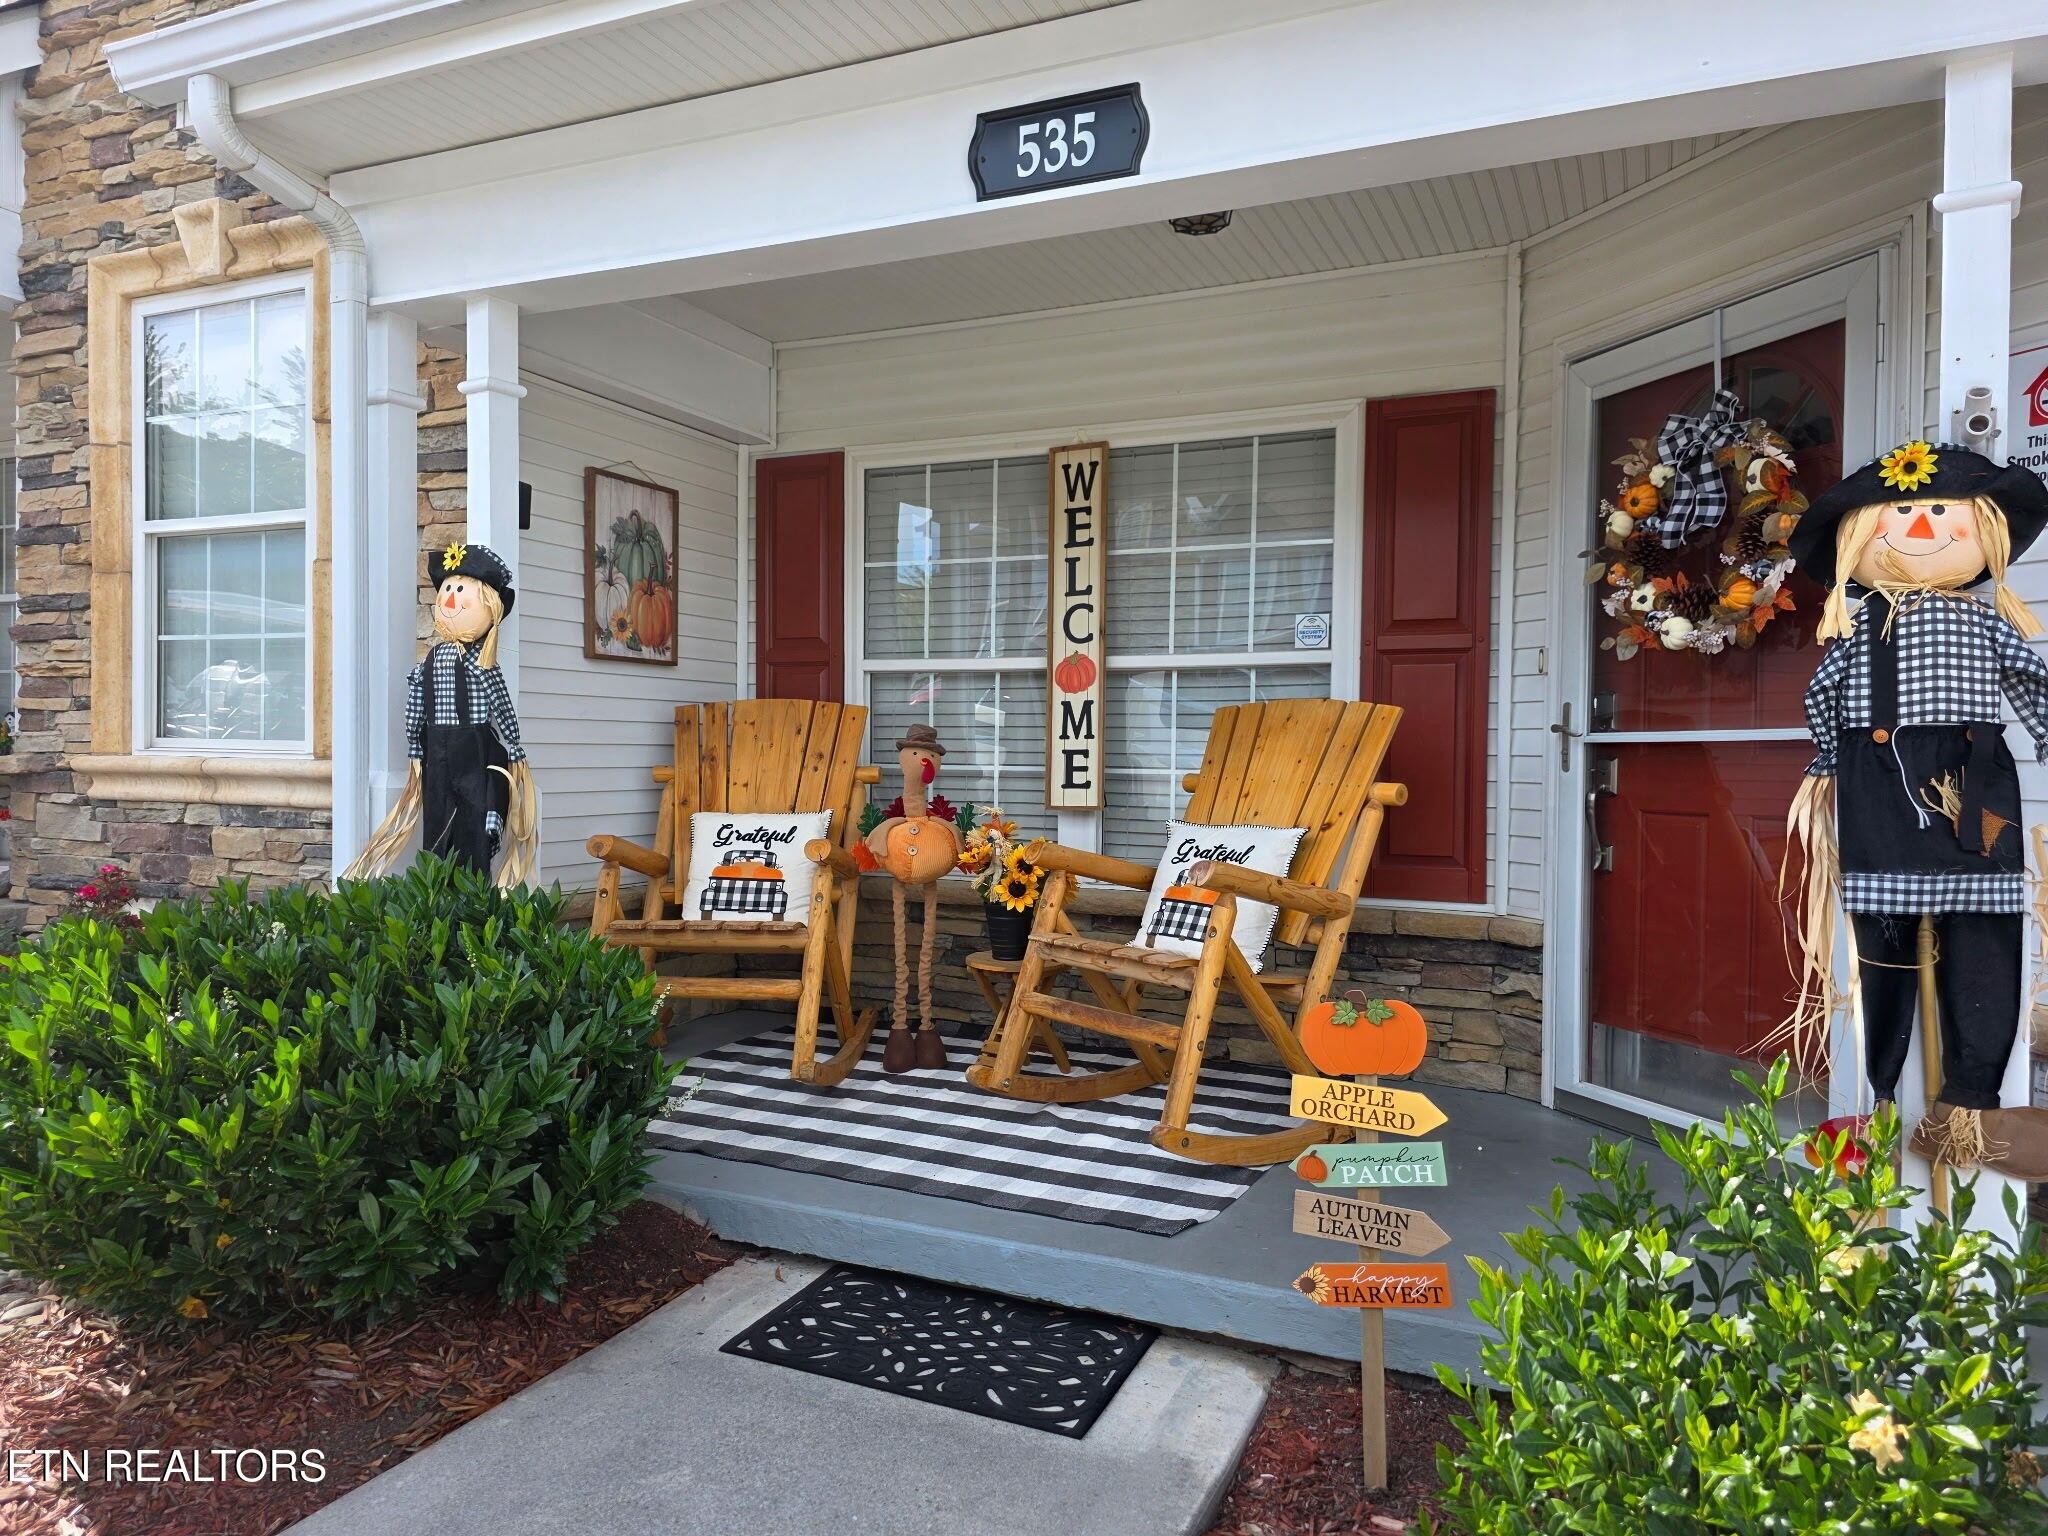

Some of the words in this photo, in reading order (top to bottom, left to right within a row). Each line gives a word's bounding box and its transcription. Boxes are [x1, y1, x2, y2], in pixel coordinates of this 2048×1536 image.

[1016, 111, 1096, 178] 535
[712, 824, 798, 850] Grateful
[1322, 1083, 1395, 1109] APPLE
[1301, 1098, 1415, 1131] ORCHARD
[1331, 1147, 1438, 1172] pumpkin
[1341, 1164, 1436, 1184] PATCH
[1310, 1199, 1411, 1231] AUTUMN
[1317, 1216, 1402, 1248] LEAVES
[1334, 1286, 1443, 1304] HARVEST
[1335, 1266, 1438, 1297] happy
